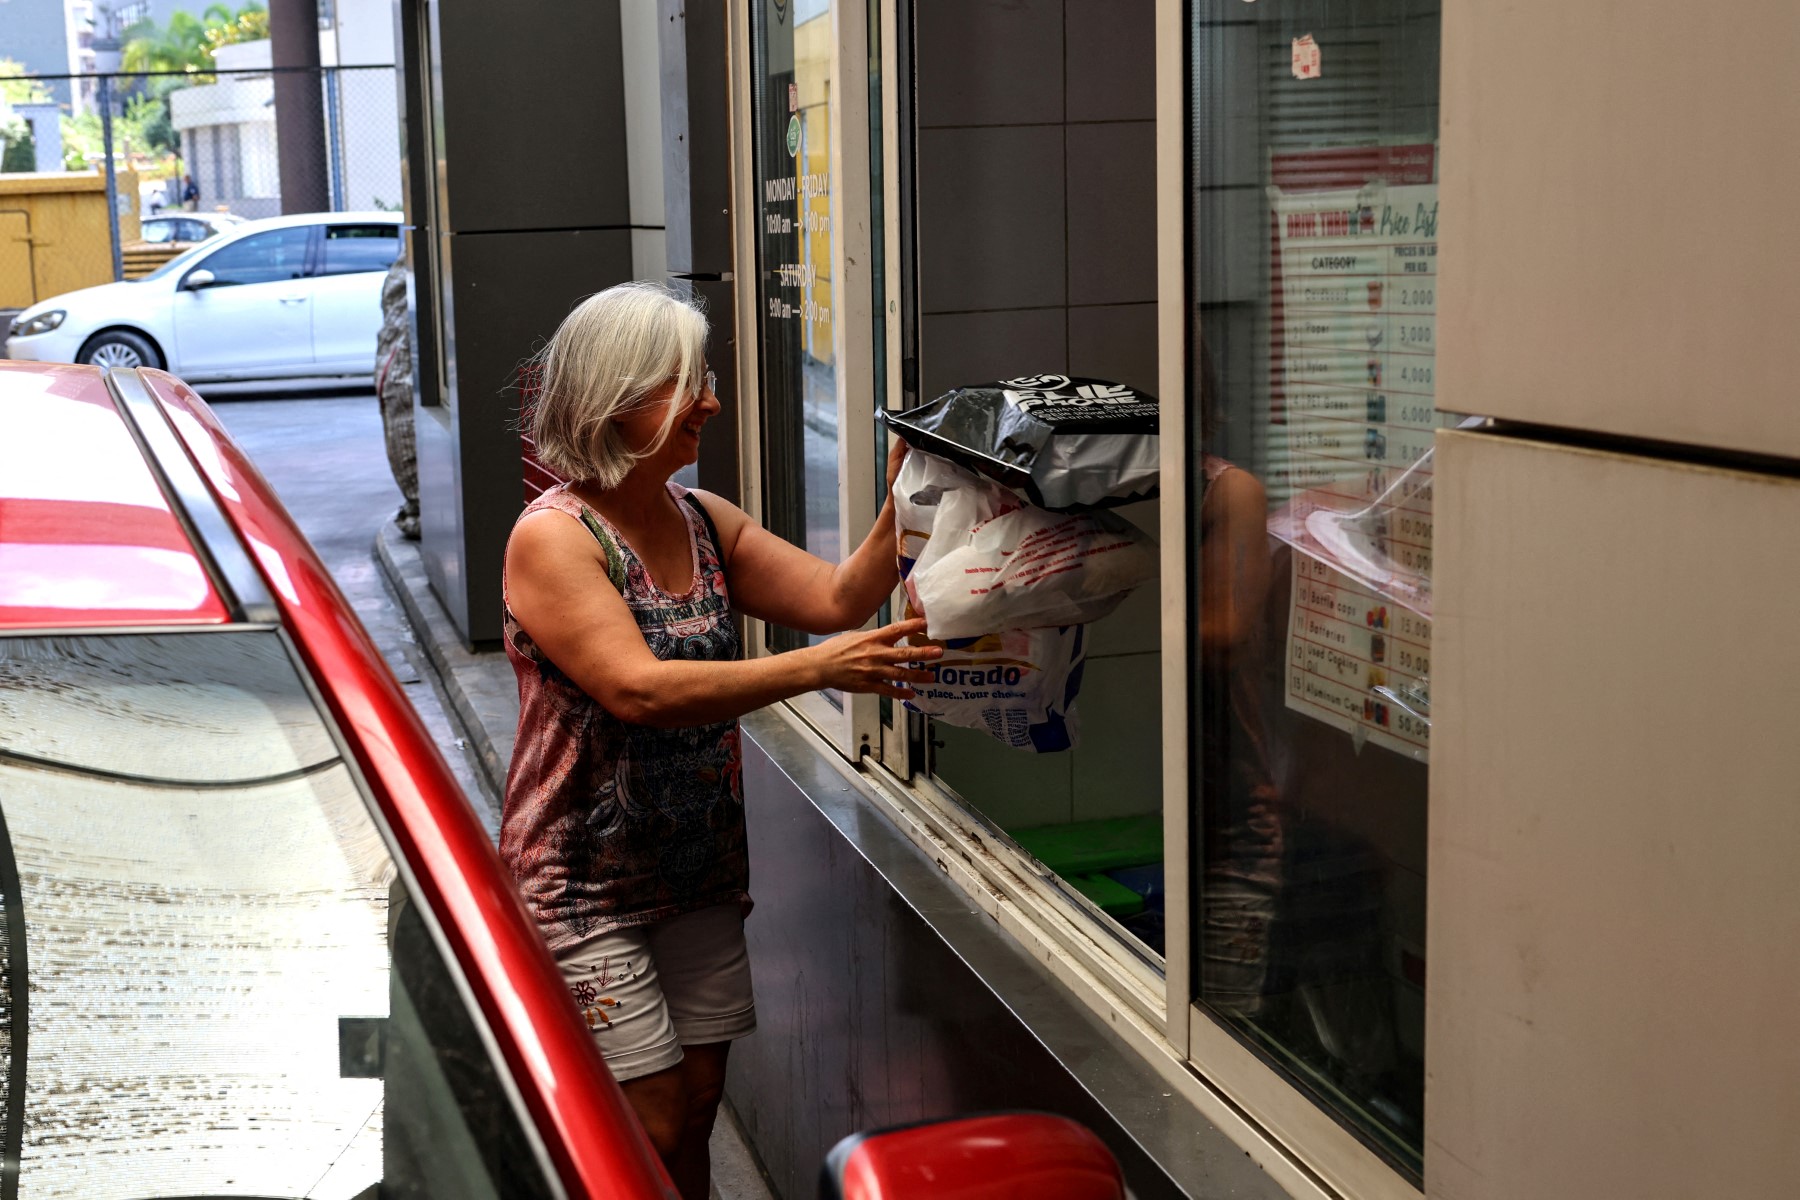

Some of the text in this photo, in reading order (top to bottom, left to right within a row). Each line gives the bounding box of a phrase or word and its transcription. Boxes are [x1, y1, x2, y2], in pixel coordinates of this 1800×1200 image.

[766, 176, 796, 203] MONDAY
[801, 172, 829, 199] FRIDAY
[766, 213, 781, 234] 10:00
[782, 217, 791, 234] am
[819, 216, 831, 238] pm
[1287, 212, 1317, 238] DRIVE
[1380, 204, 1409, 236] Price
[1414, 201, 1439, 238] List
[780, 263, 817, 288] SATURDAY
[1311, 255, 1357, 271] CATEGORY
[769, 297, 782, 319] 9:00
[782, 303, 792, 319] am
[818, 306, 830, 328] pm
[1018, 396, 1141, 413] PHONE
[1311, 591, 1335, 610] Bottle
[1308, 621, 1346, 645] Batteries
